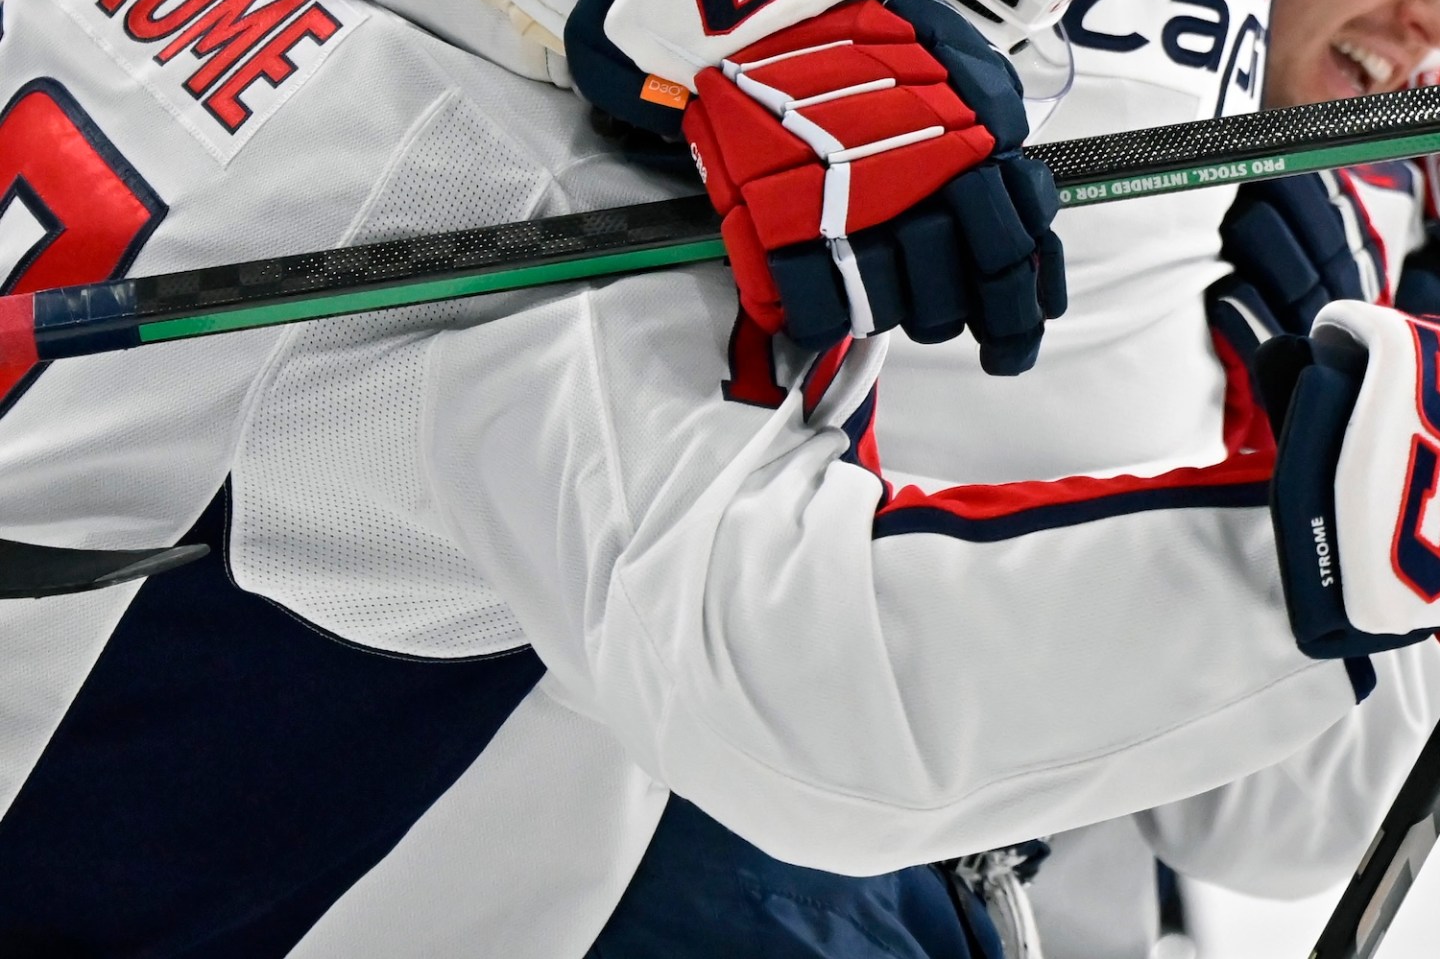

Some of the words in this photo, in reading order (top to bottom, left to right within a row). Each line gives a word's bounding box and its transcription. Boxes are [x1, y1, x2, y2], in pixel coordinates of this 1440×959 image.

[1192, 162, 1247, 183] STOCK.
[1252, 158, 1286, 174] PRO
[1076, 184, 1107, 201] FOR
[1111, 172, 1189, 196] INTENDED
[1311, 516, 1334, 587] STROME
